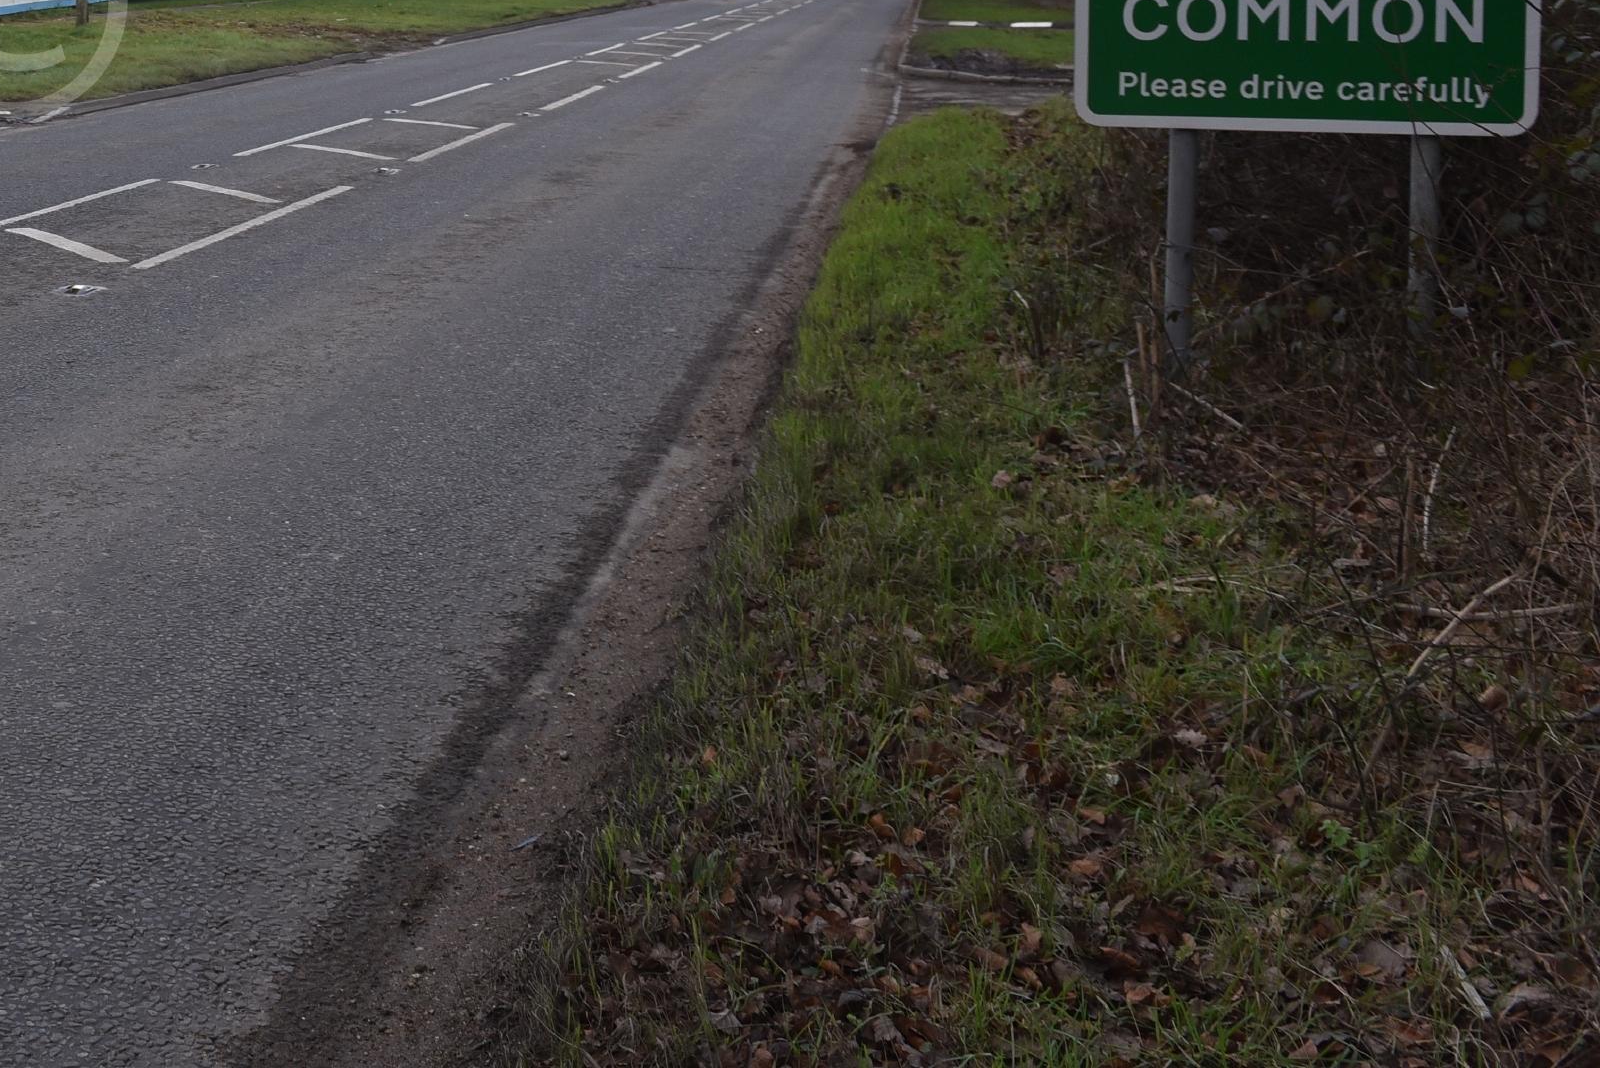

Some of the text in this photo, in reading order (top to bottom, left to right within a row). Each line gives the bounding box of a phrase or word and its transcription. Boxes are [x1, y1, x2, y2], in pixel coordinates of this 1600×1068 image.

[1118, 71, 1494, 108] Please drive carefully
